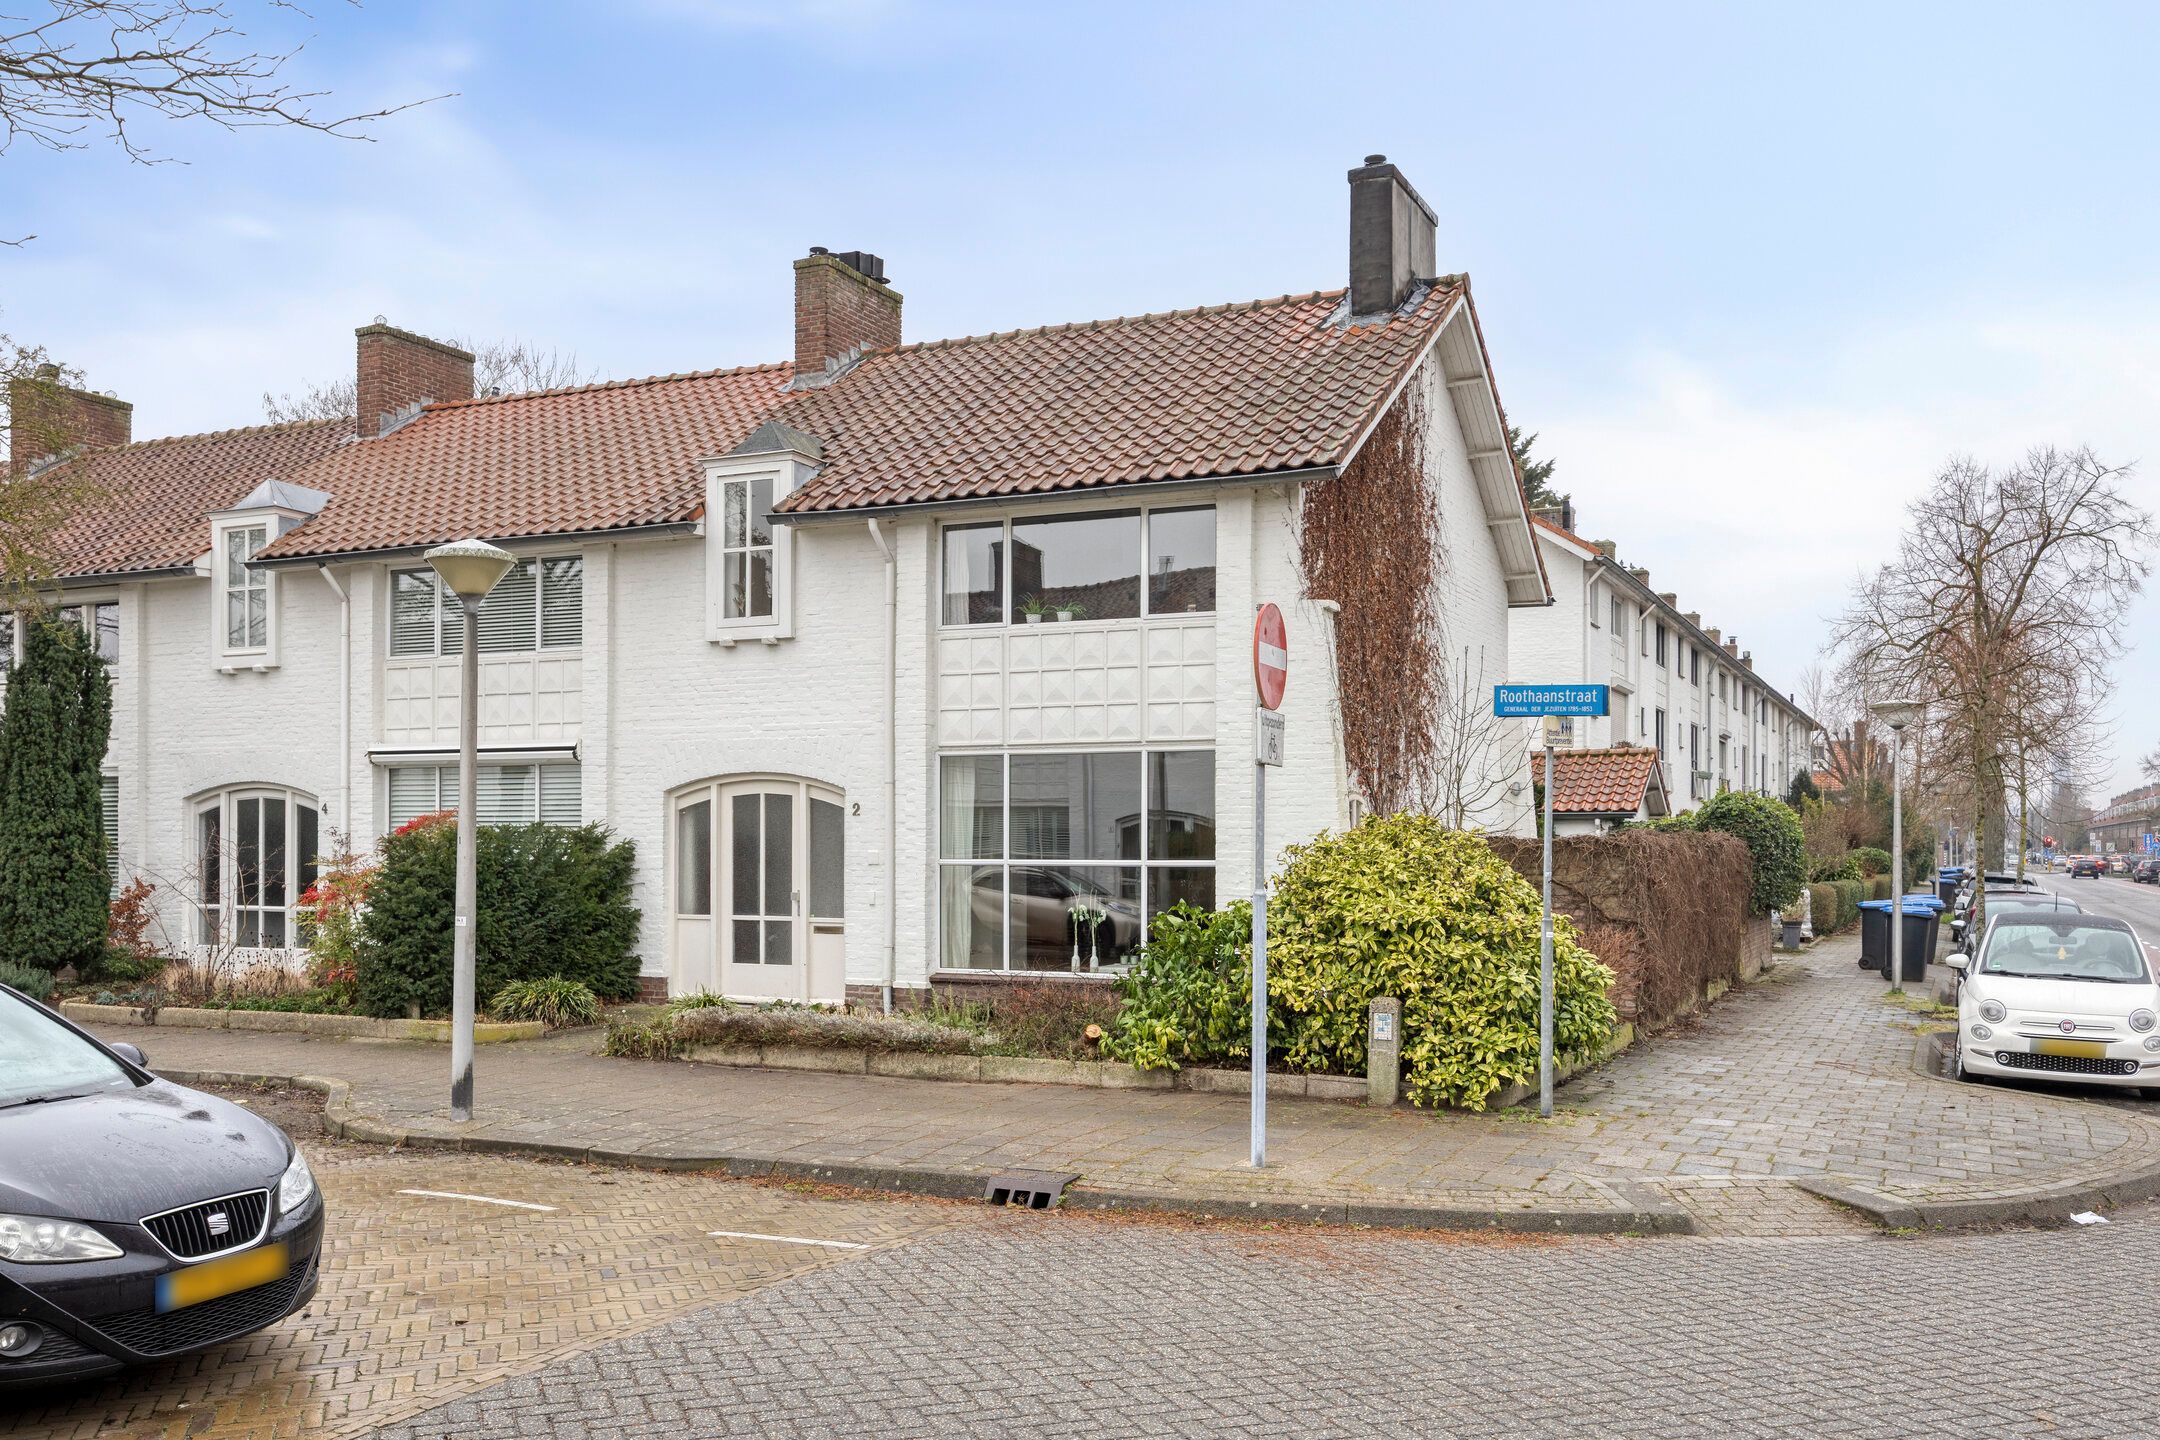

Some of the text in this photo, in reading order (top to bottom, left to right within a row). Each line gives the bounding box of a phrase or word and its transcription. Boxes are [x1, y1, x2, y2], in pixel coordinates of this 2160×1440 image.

[1500, 689, 1598, 703] Roothaanstraat
[321, 802, 329, 815] 4
[852, 802, 861, 816] 2
